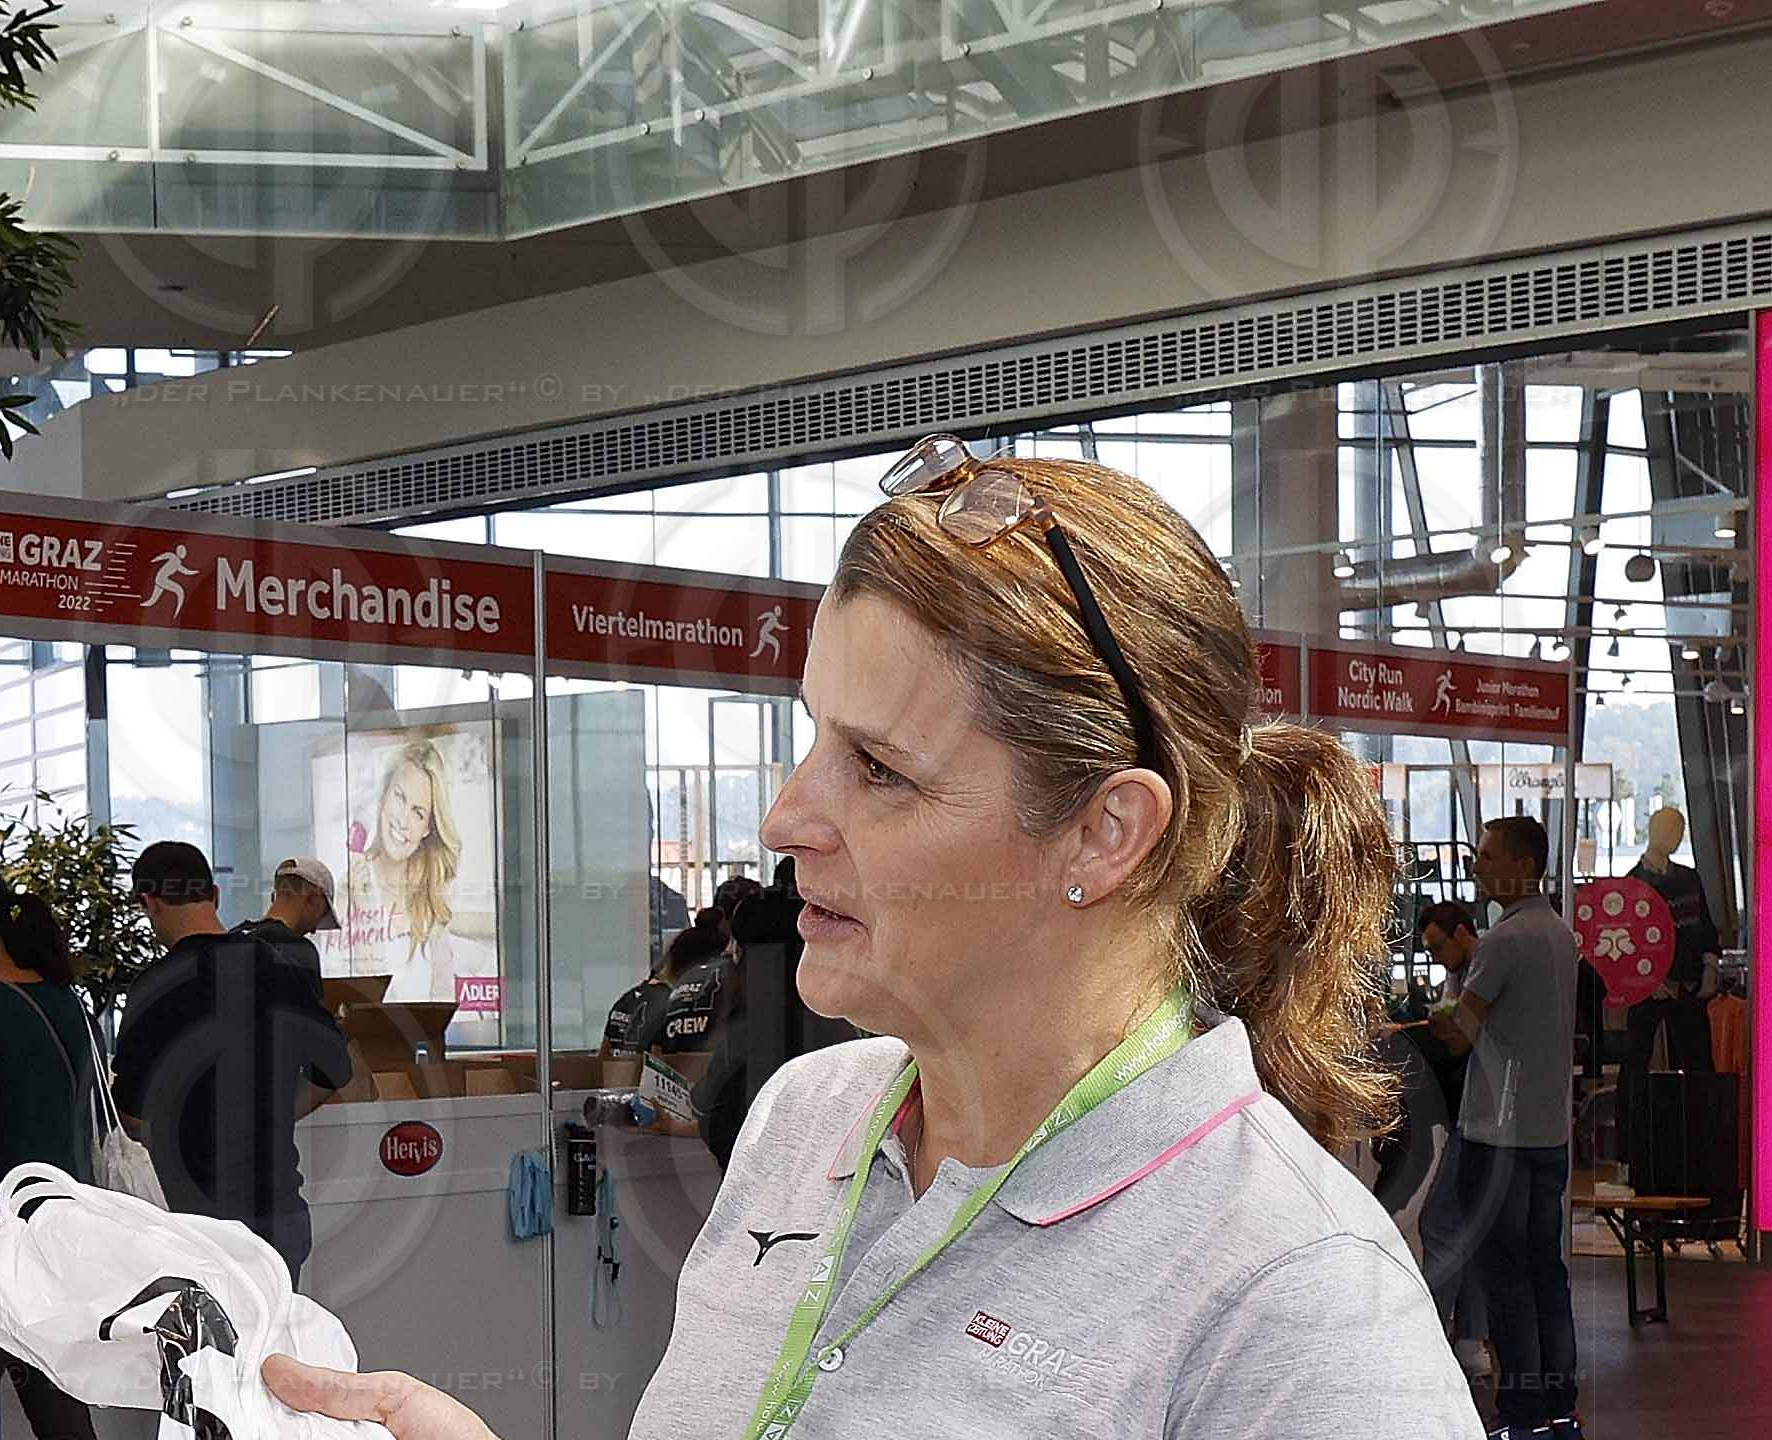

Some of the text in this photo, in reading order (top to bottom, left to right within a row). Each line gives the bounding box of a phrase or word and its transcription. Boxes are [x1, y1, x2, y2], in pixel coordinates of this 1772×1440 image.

[18, 533, 103, 571] GRAZ
[0, 568, 79, 592] MARATHON
[58, 595, 92, 611] 2022
[216, 558, 501, 633] Merchandise
[571, 604, 744, 648] Viertelmarathon
[1349, 659, 1404, 688] City Run
[1337, 687, 1415, 714] Nordic Walk
[460, 983, 500, 1002] ADLER
[666, 1015, 709, 1039] CREW
[387, 1136, 438, 1163] Hervis
[966, 1324, 1003, 1345] ZEITUNG
[972, 1314, 1011, 1336] KLEINE
[1008, 1333, 1074, 1377] GRAZ
